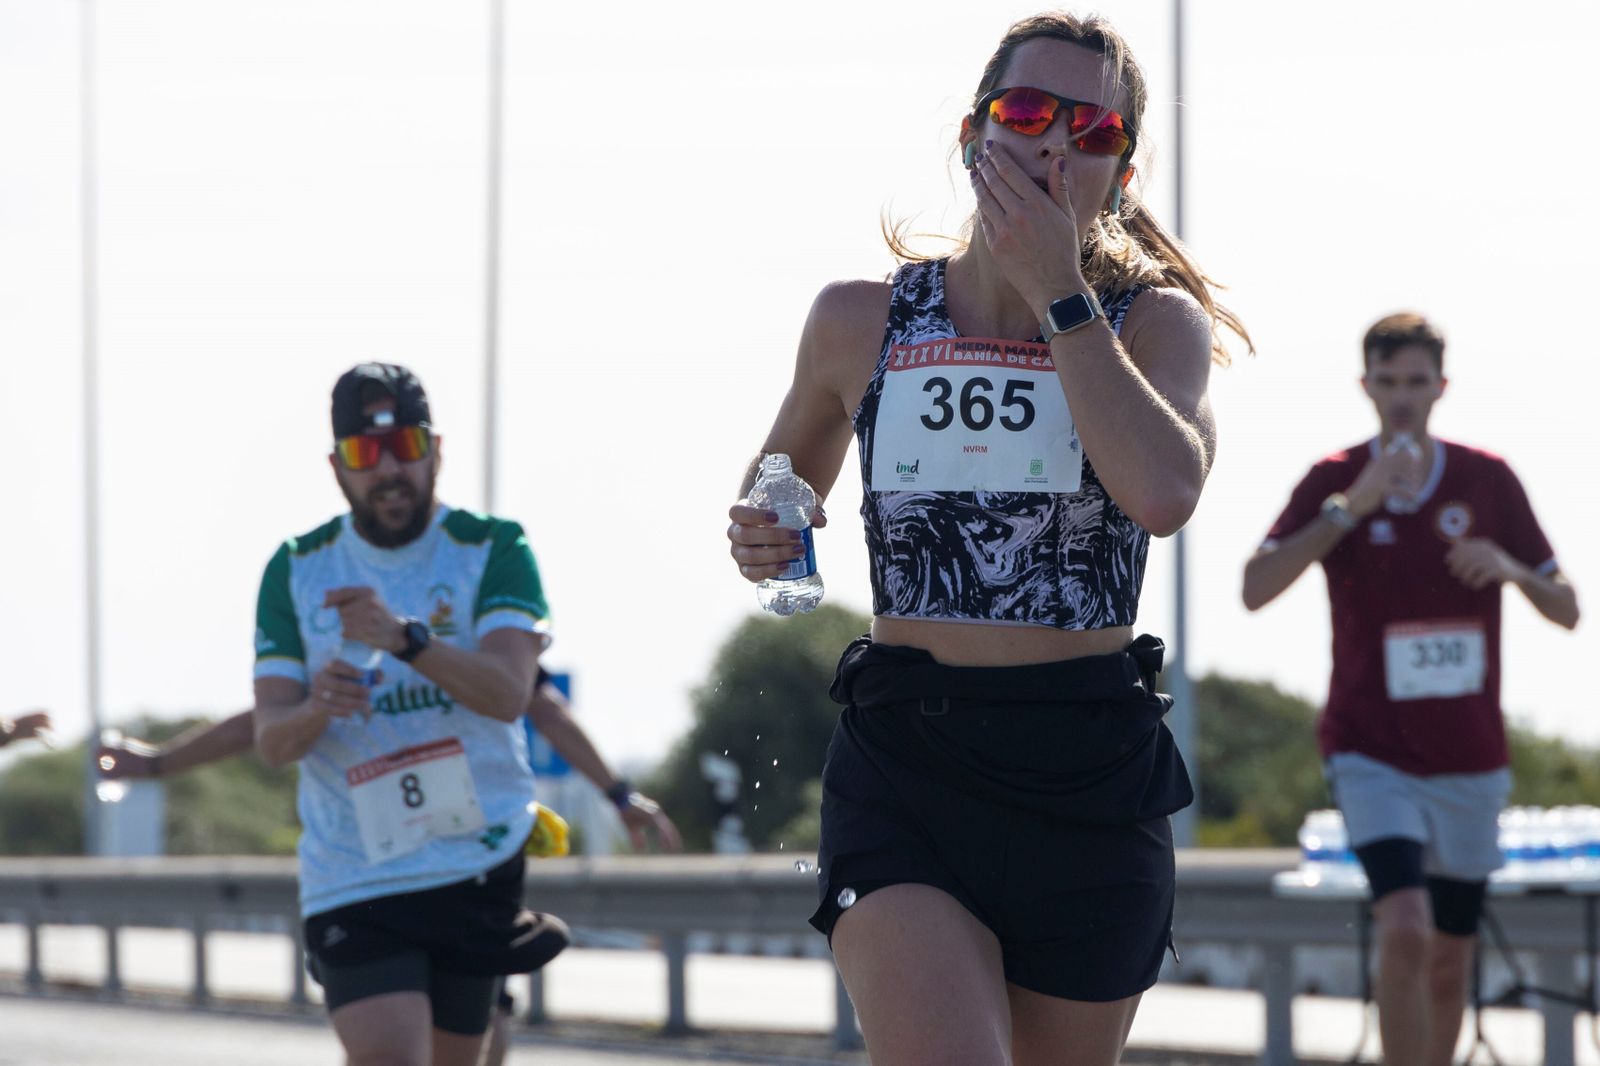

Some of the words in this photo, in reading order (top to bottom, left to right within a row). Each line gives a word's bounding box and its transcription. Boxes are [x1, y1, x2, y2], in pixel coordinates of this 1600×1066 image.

[895, 344, 950, 366] XXXVI
[955, 342, 1002, 353] MEDIA
[1005, 345, 1051, 357] MARA
[1007, 354, 1027, 365] DE
[919, 376, 1036, 432] 365
[962, 445, 988, 454] NVRM
[896, 458, 920, 475] imd
[400, 772, 425, 808] 8
